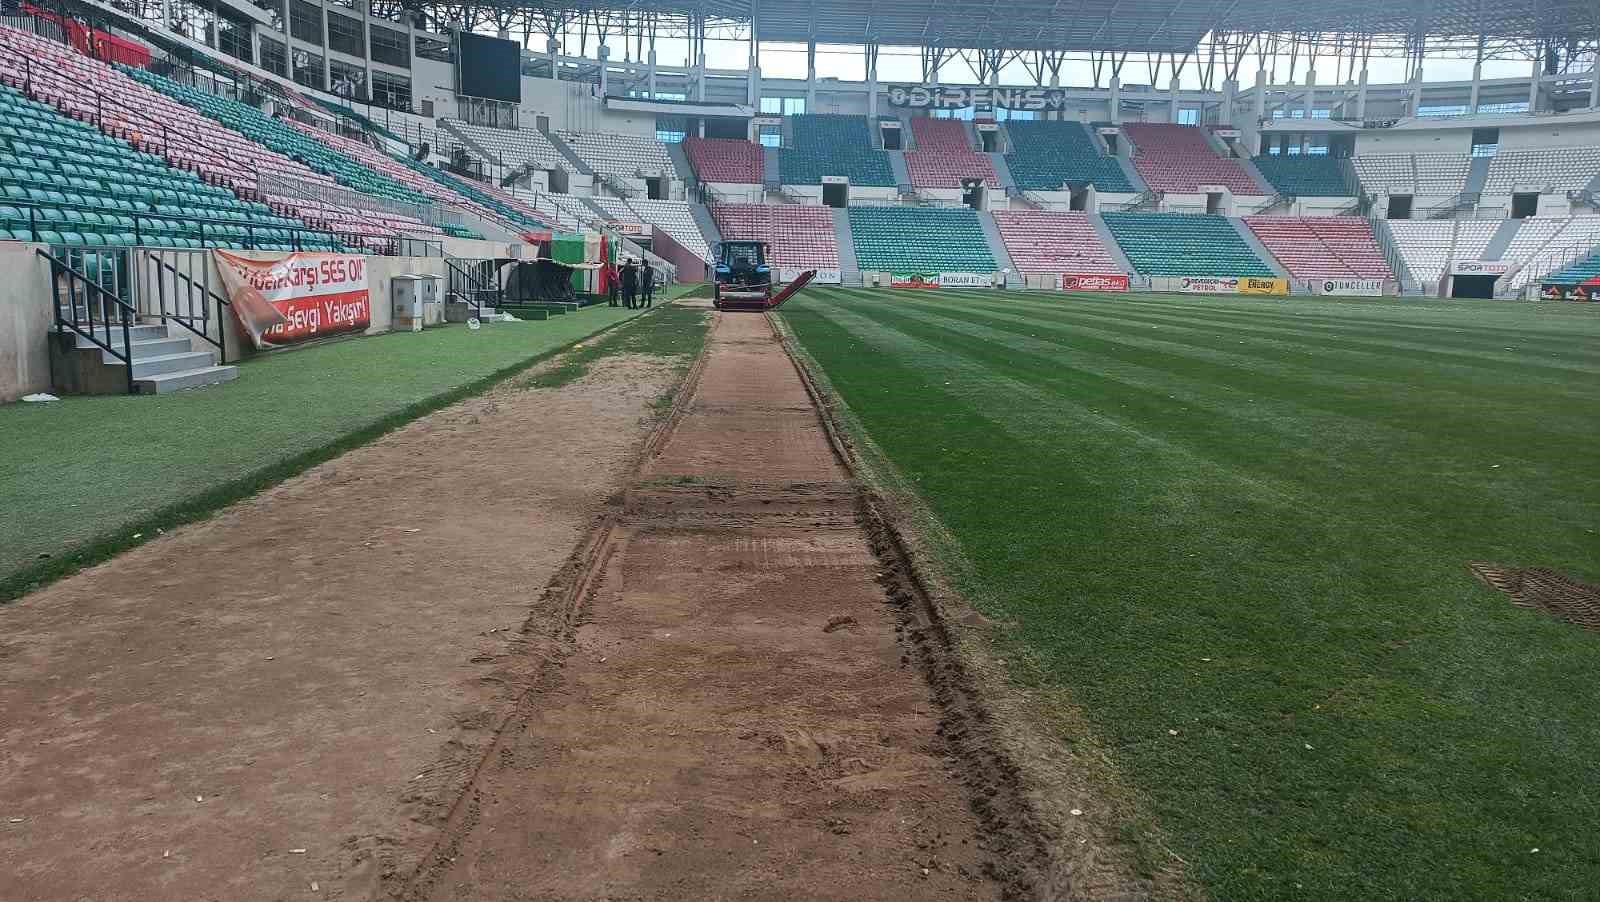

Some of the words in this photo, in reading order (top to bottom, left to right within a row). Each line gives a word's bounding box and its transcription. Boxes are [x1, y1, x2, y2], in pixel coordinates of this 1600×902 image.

[320, 260, 346, 284] SES
[1247, 280, 1274, 289] ENERGY
[287, 301, 321, 333] Sevgi
